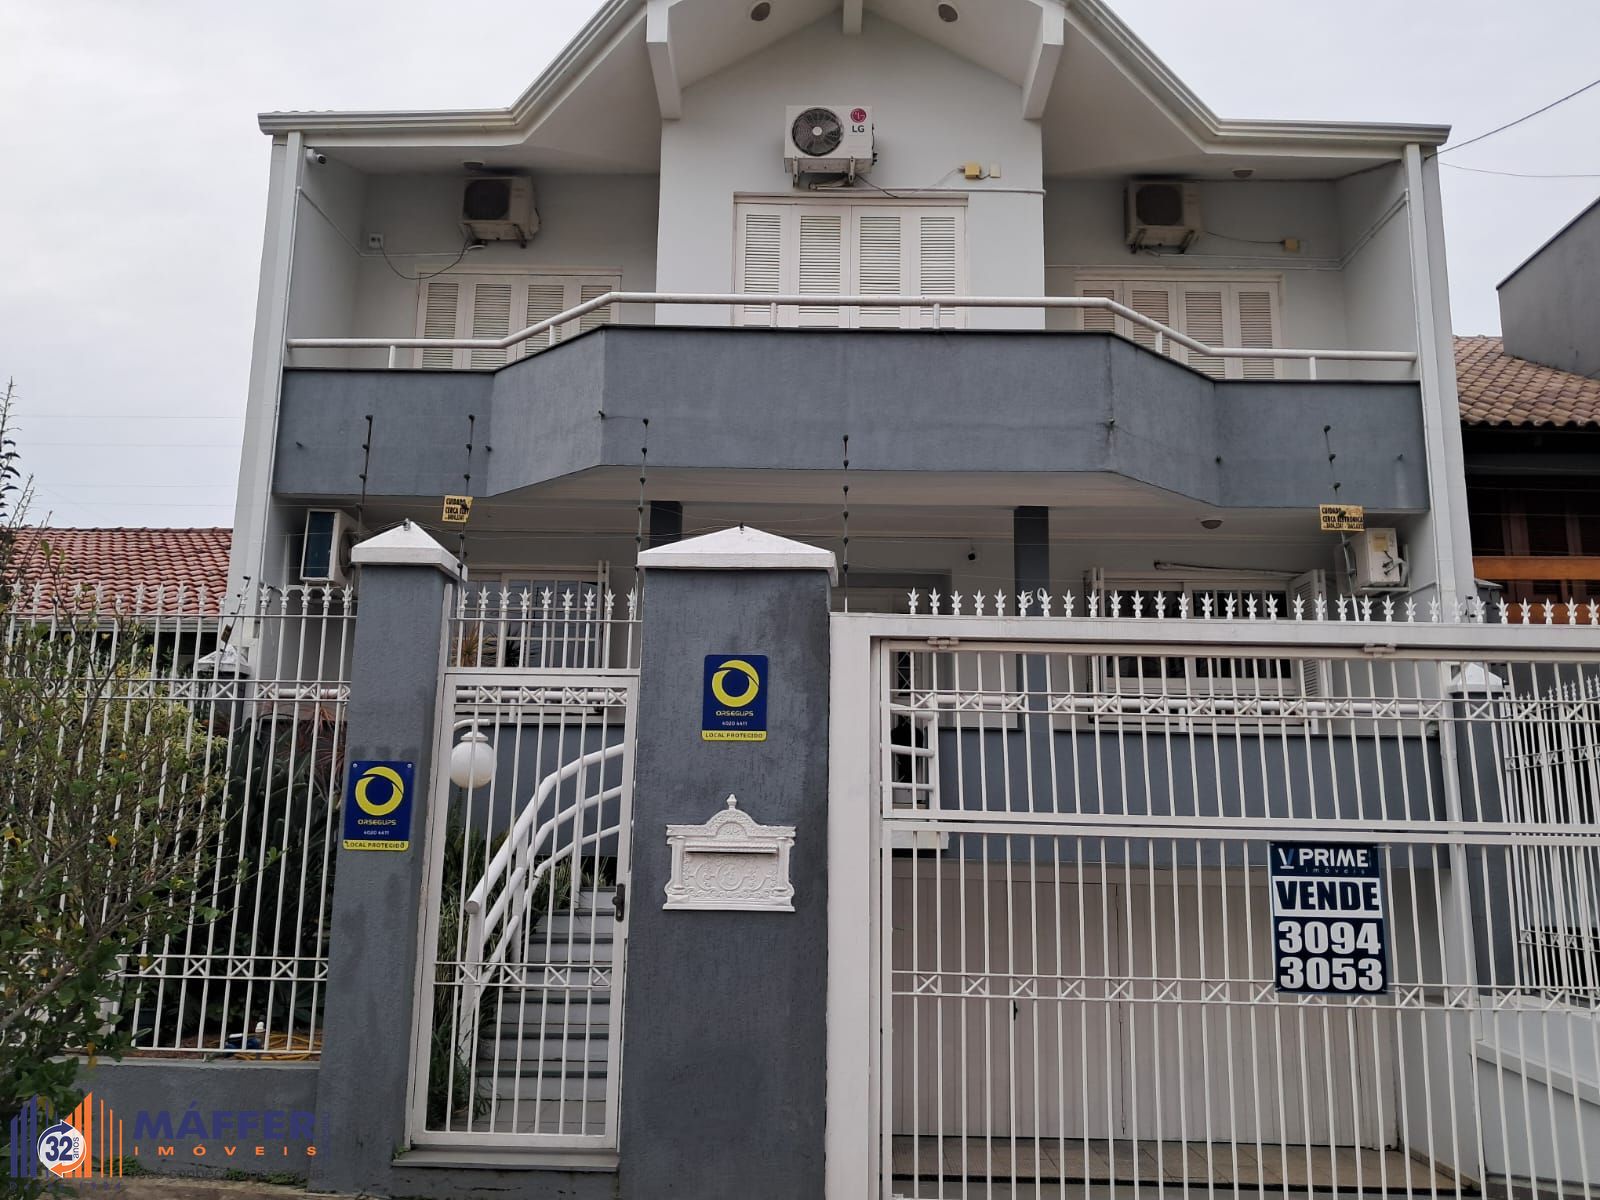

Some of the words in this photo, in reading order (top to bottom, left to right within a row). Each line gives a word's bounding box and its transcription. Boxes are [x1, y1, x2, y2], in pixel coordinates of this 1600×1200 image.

[851, 125, 865, 133] LG
[357, 818, 397, 826] ORSEGUPS
[1299, 848, 1369, 867] PRIME
[1275, 880, 1380, 911] VENDE
[1278, 920, 1382, 955] 3094
[1279, 956, 1383, 991] 3053
